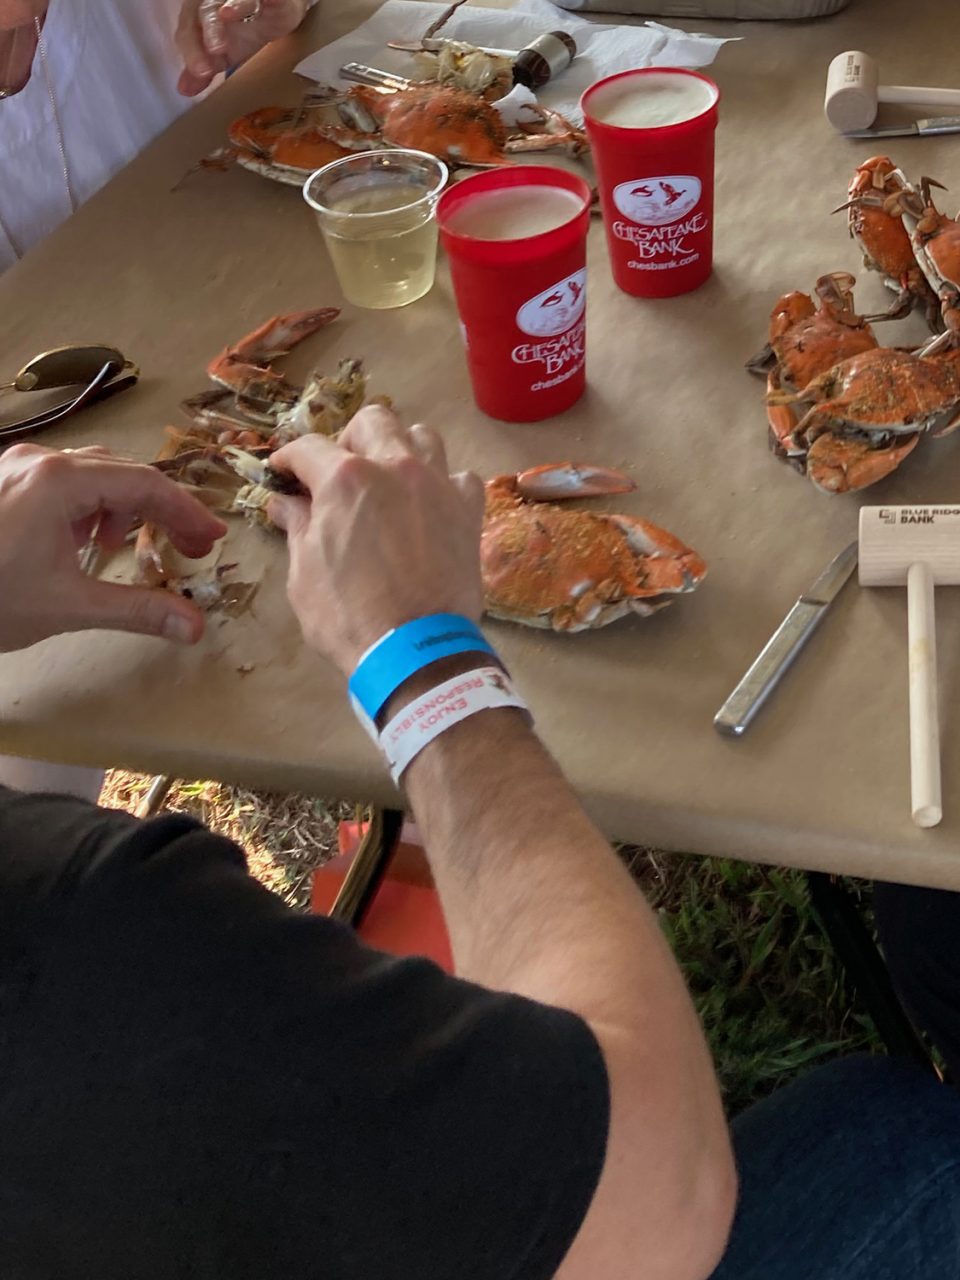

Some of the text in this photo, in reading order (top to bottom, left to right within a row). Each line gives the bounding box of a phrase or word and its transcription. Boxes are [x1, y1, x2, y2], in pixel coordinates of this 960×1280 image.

[612, 212, 709, 246] CHESAPEAKE
[639, 236, 695, 258] BANK
[627, 253, 699, 271] chesbank.com
[900, 516, 935, 524] BANK
[418, 697, 469, 733] ENJOY
